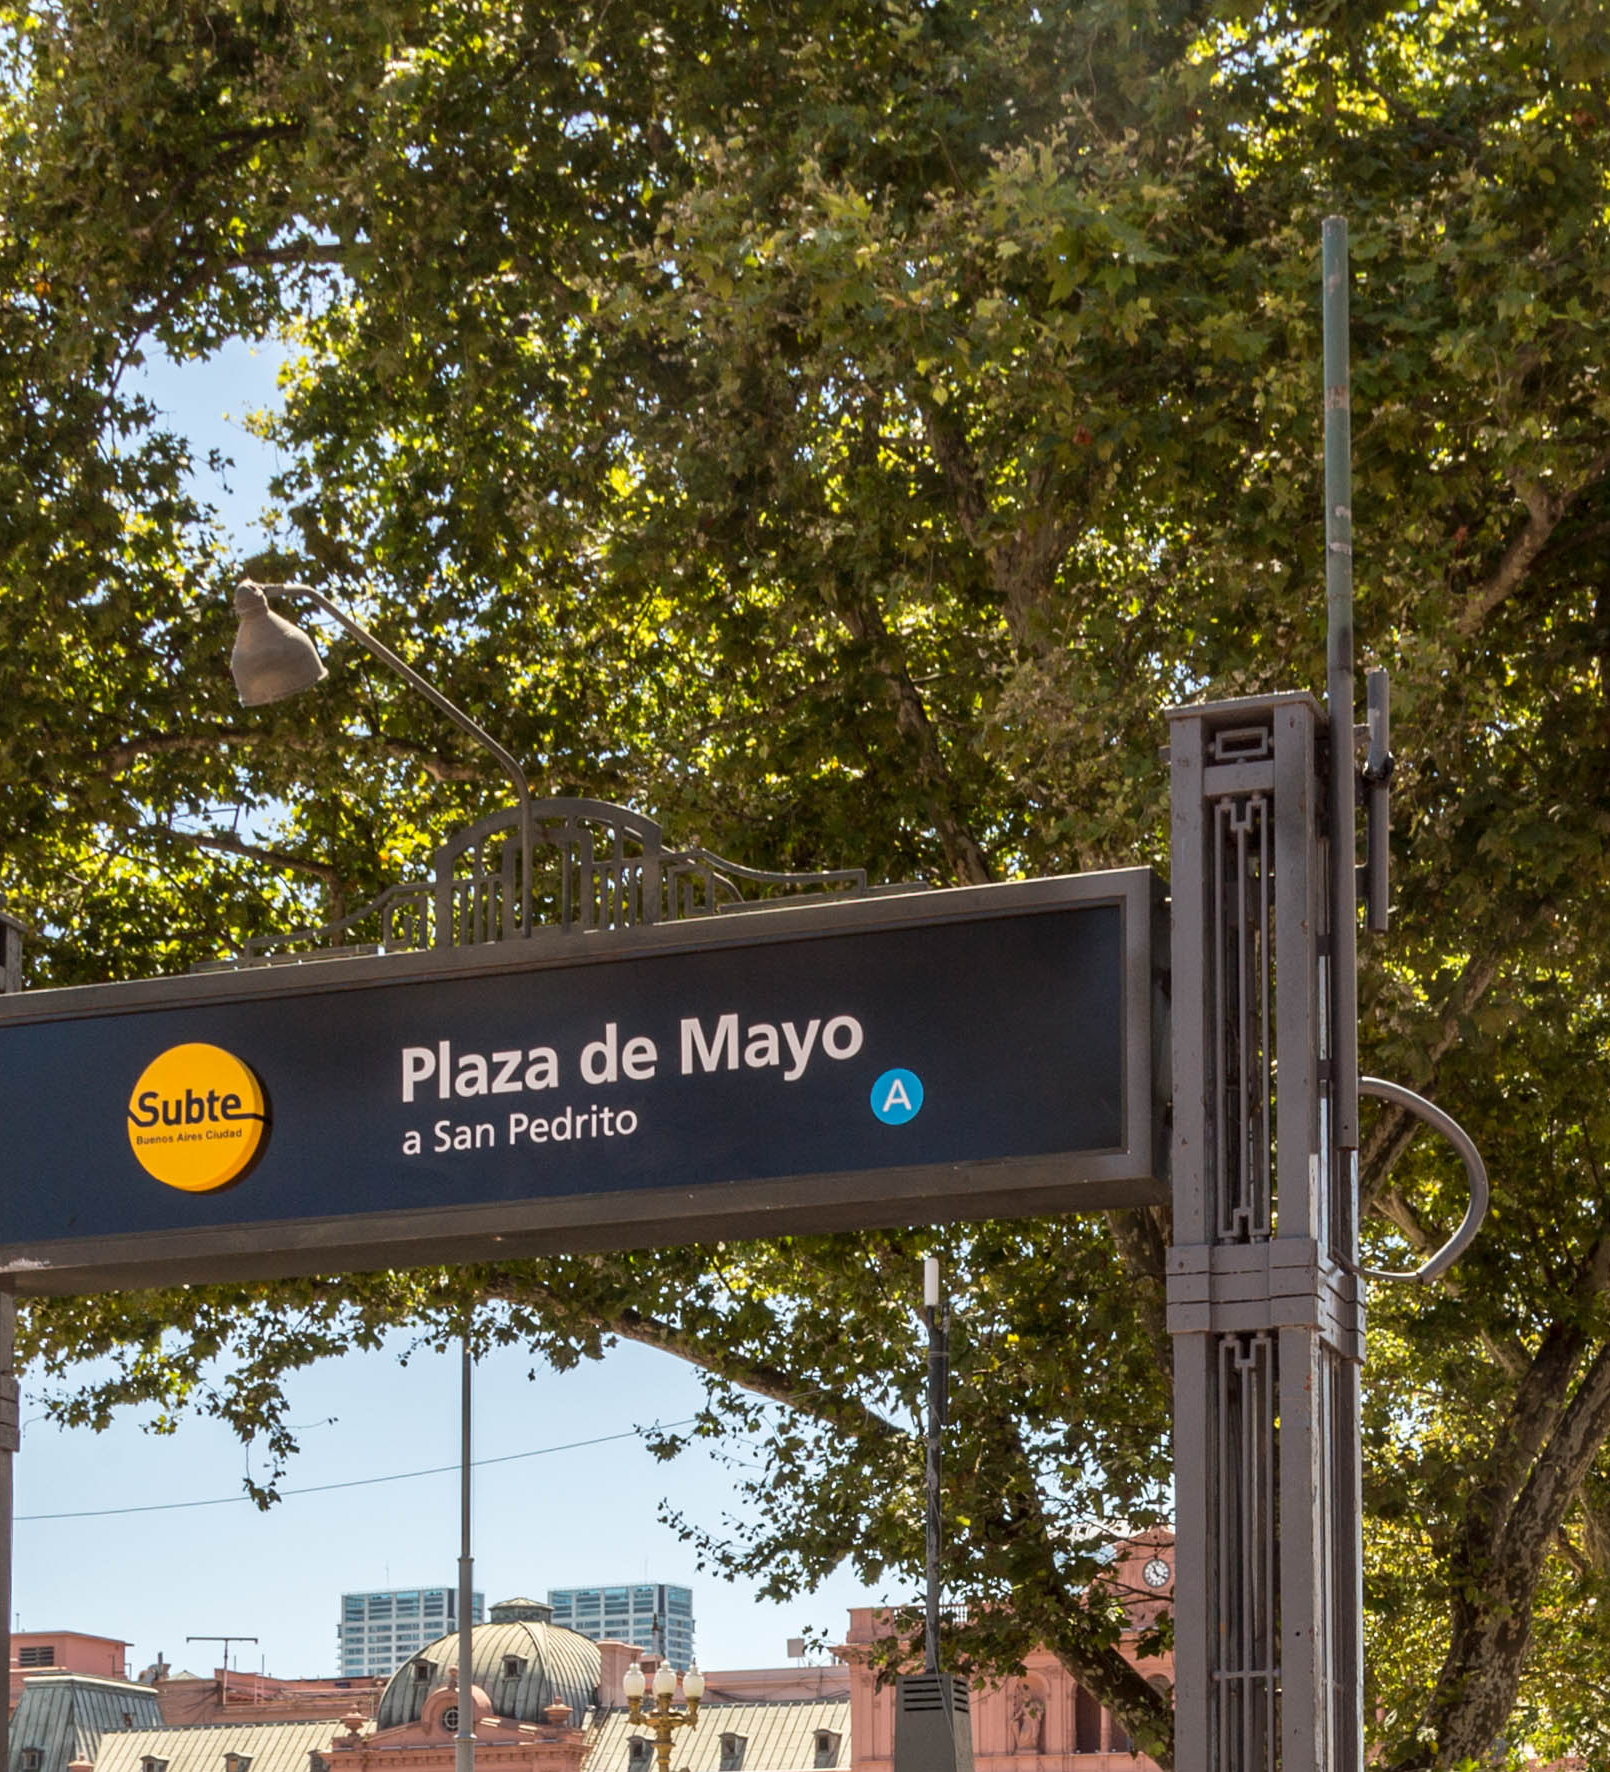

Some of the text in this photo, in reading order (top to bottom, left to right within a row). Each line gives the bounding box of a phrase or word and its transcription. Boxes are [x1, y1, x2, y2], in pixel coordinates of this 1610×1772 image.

[402, 1013, 863, 1103] Plaza de Mayo
[132, 1088, 248, 1127] Subte
[882, 1078, 912, 1112] A
[136, 1128, 242, 1145] Buenos Aires Ciudad
[402, 1104, 638, 1155] a San Pedrito
